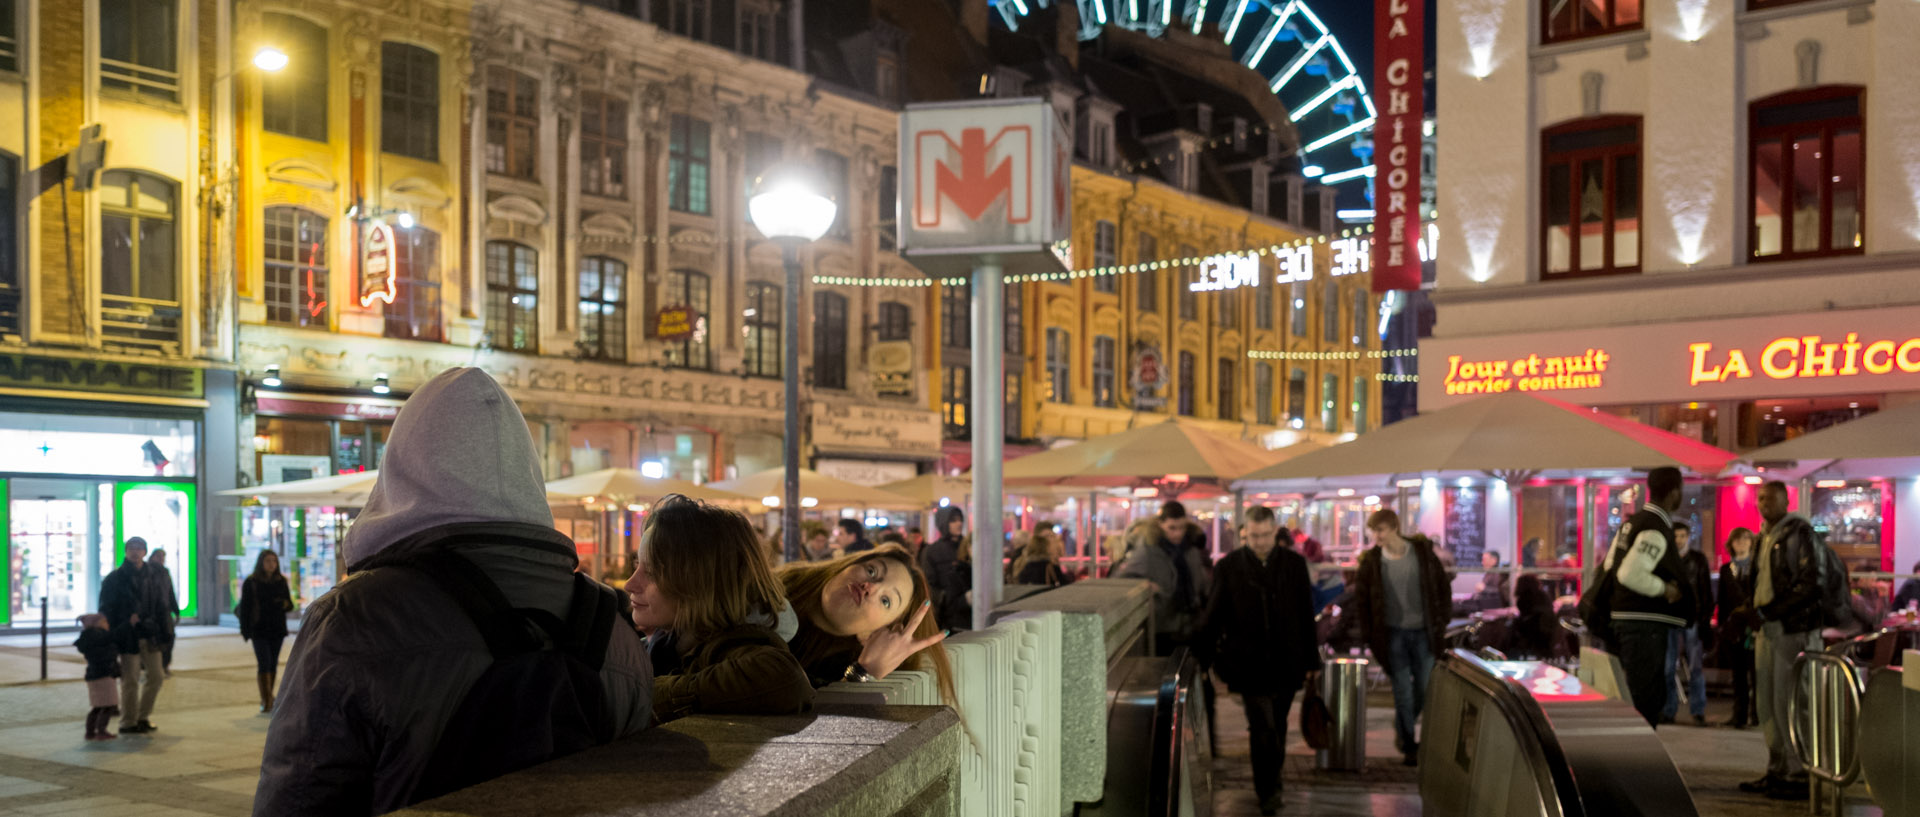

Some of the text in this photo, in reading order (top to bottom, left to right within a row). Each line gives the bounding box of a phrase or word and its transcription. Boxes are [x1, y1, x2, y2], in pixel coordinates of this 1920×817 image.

[1444, 348, 1611, 386] Jour et nuit
[1689, 342, 1753, 386] LA
[1446, 373, 1603, 396] service continu
